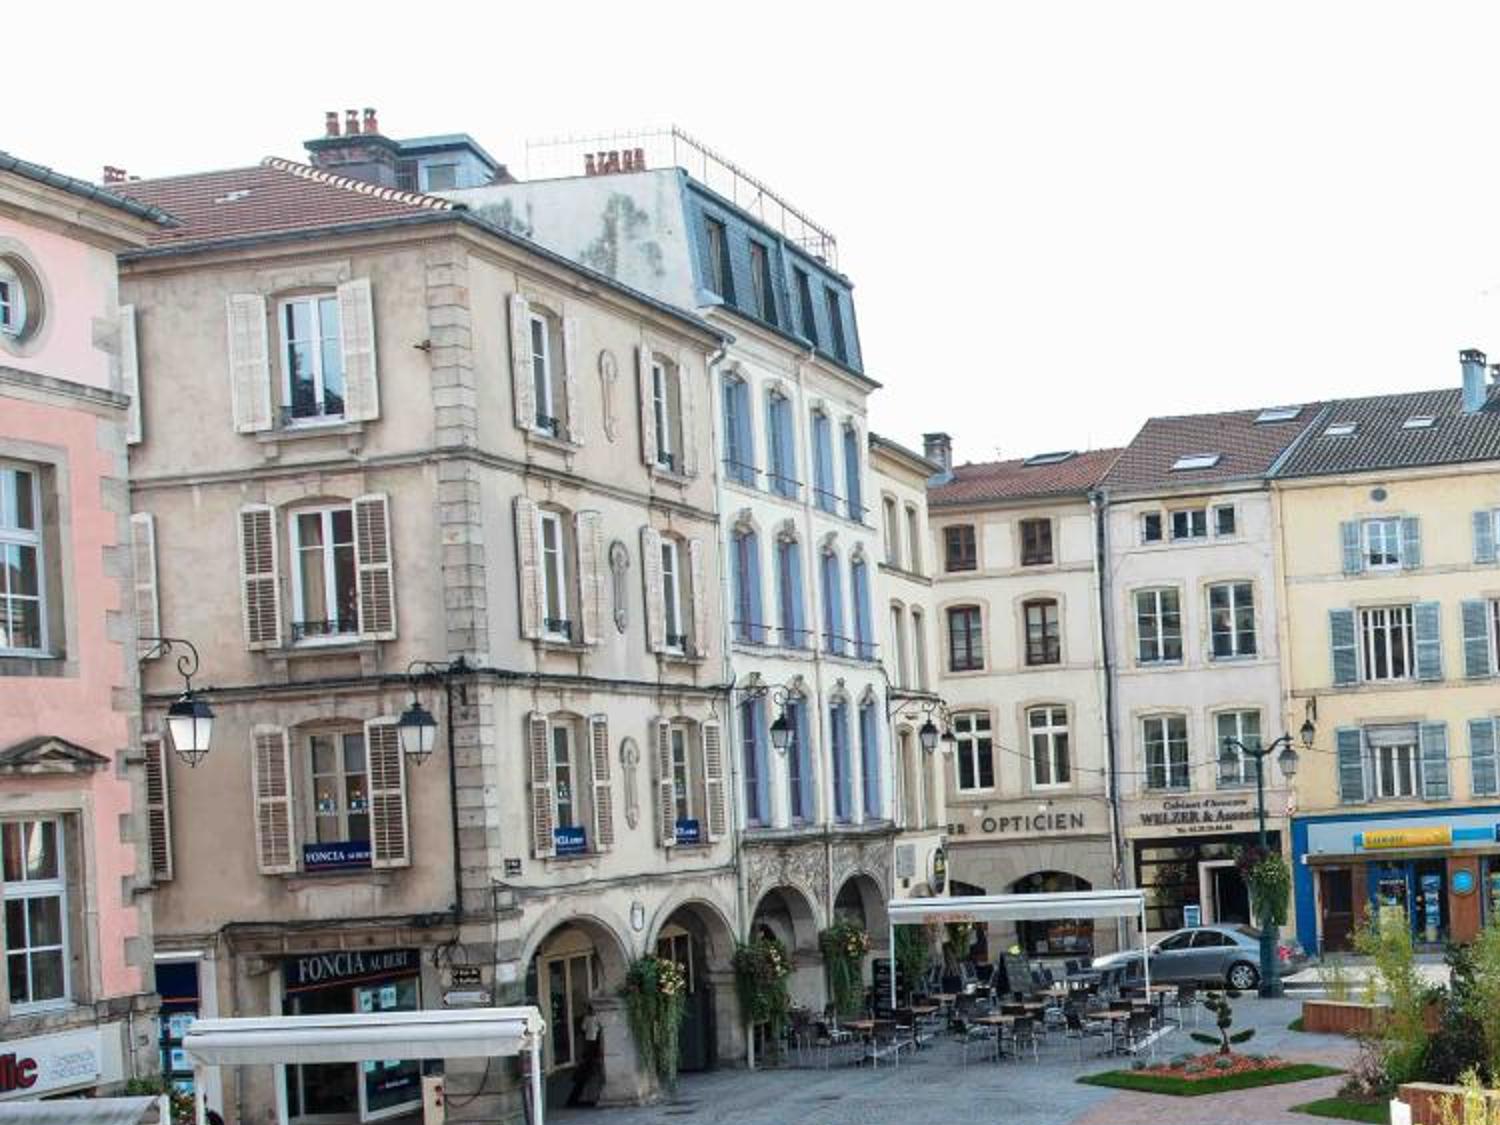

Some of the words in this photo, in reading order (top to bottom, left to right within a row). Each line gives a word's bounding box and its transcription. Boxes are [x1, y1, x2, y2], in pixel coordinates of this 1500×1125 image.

[981, 813, 1085, 833] OPTICIEN
[1140, 811, 1200, 826] WELZER
[1203, 810, 1214, 823] &
[1216, 808, 1269, 822] Associs
[305, 850, 345, 863] FONCIA
[298, 952, 365, 982] FONCIA
